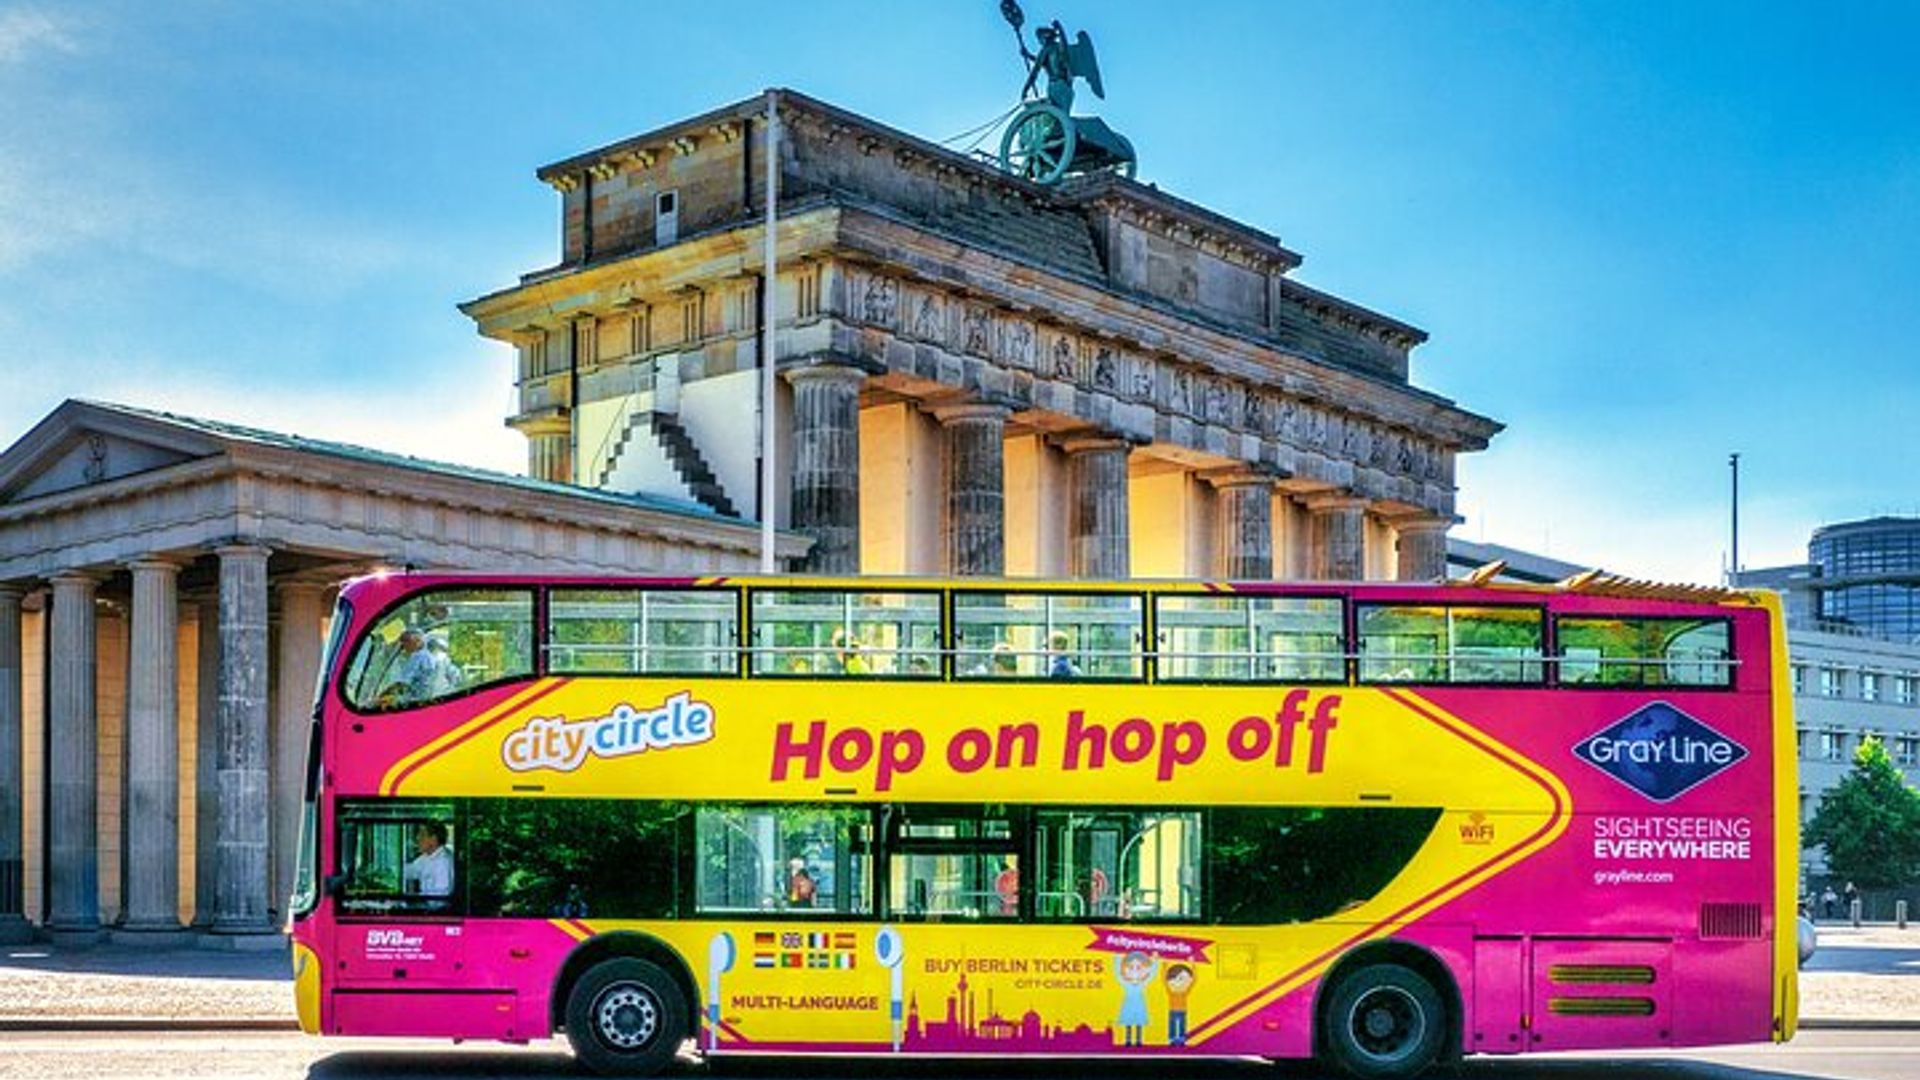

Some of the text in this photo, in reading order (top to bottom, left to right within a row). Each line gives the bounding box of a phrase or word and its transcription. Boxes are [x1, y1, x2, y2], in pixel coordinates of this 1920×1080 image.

[509, 701, 708, 763] city circle
[770, 689, 1342, 791] Hop on hop off
[1589, 737, 1733, 764] Gray Line
[1594, 817, 1750, 838] SIGHTSEEING
[1594, 840, 1750, 859] EVERYWHERE
[1594, 869, 1673, 886] grayline.com
[925, 958, 1104, 973] BUY BERLIN TICKETS
[731, 996, 879, 1010] MULTI-LANGUAGE
